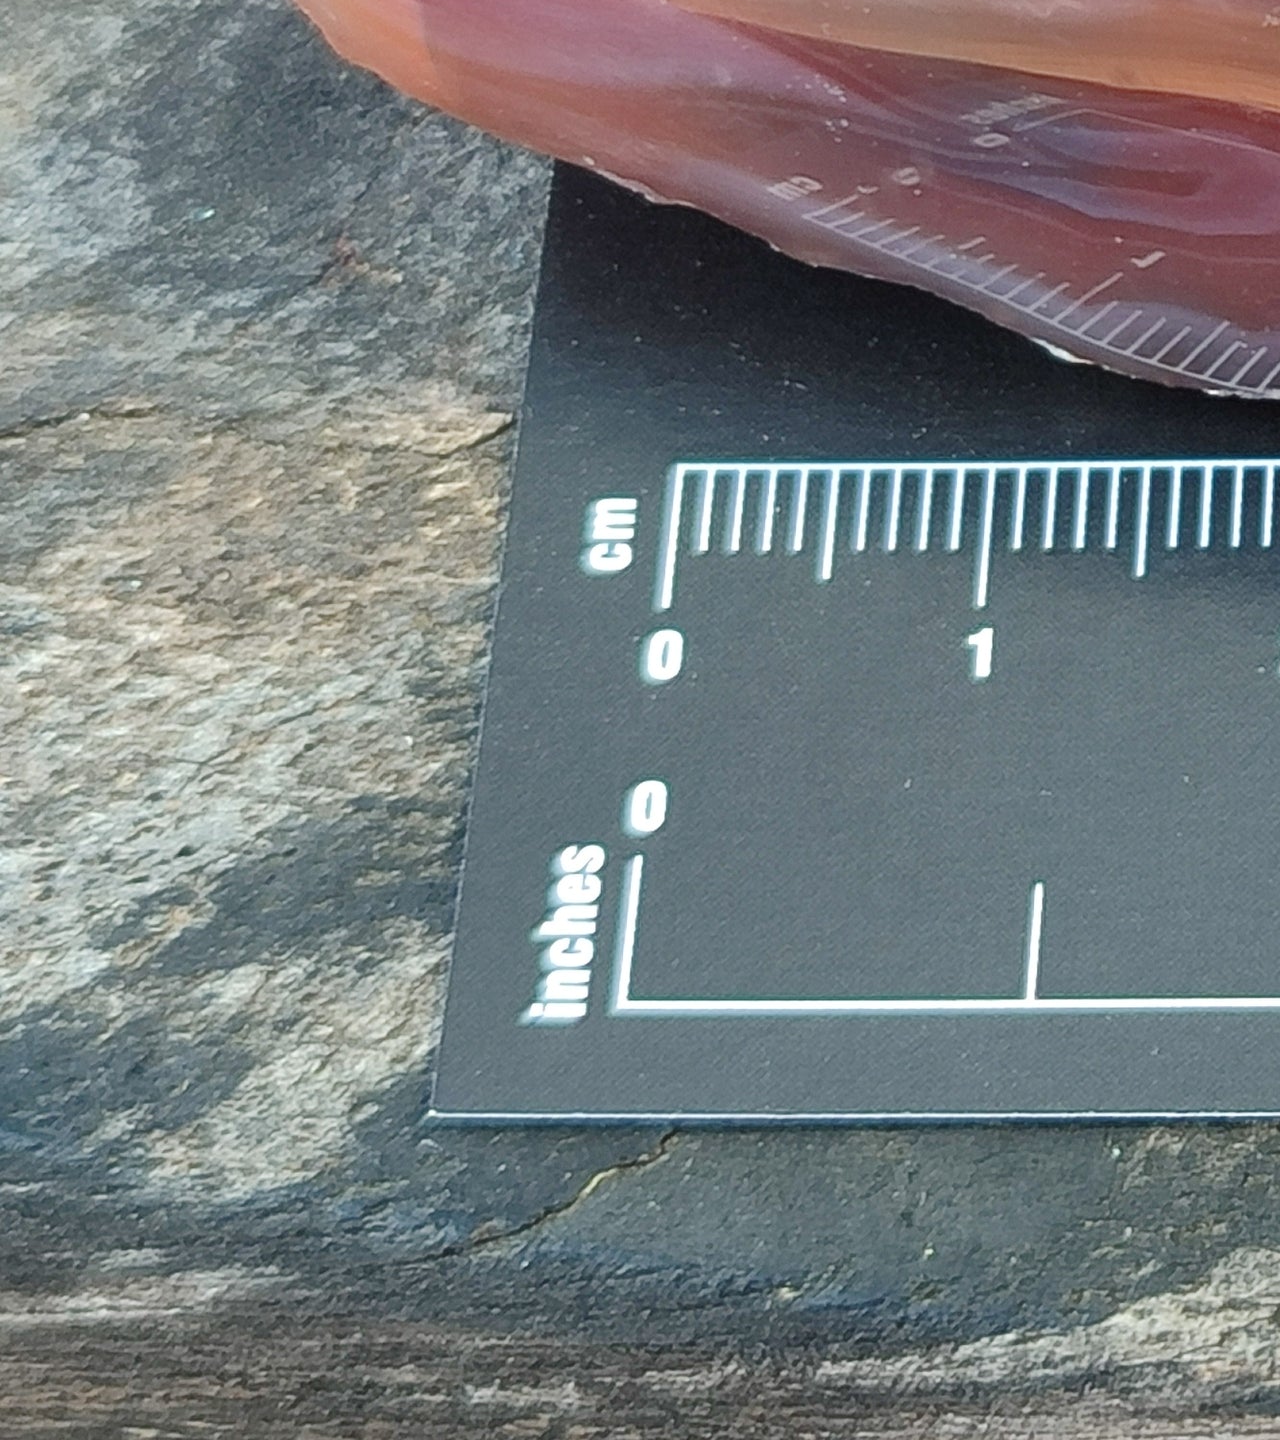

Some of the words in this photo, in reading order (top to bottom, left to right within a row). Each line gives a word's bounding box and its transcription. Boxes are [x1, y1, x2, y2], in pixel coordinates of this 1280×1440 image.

[585, 497, 638, 573] cm
[643, 629, 684, 681] 0
[967, 627, 994, 678] 1
[626, 780, 668, 835] 0
[523, 844, 606, 1023] inches
